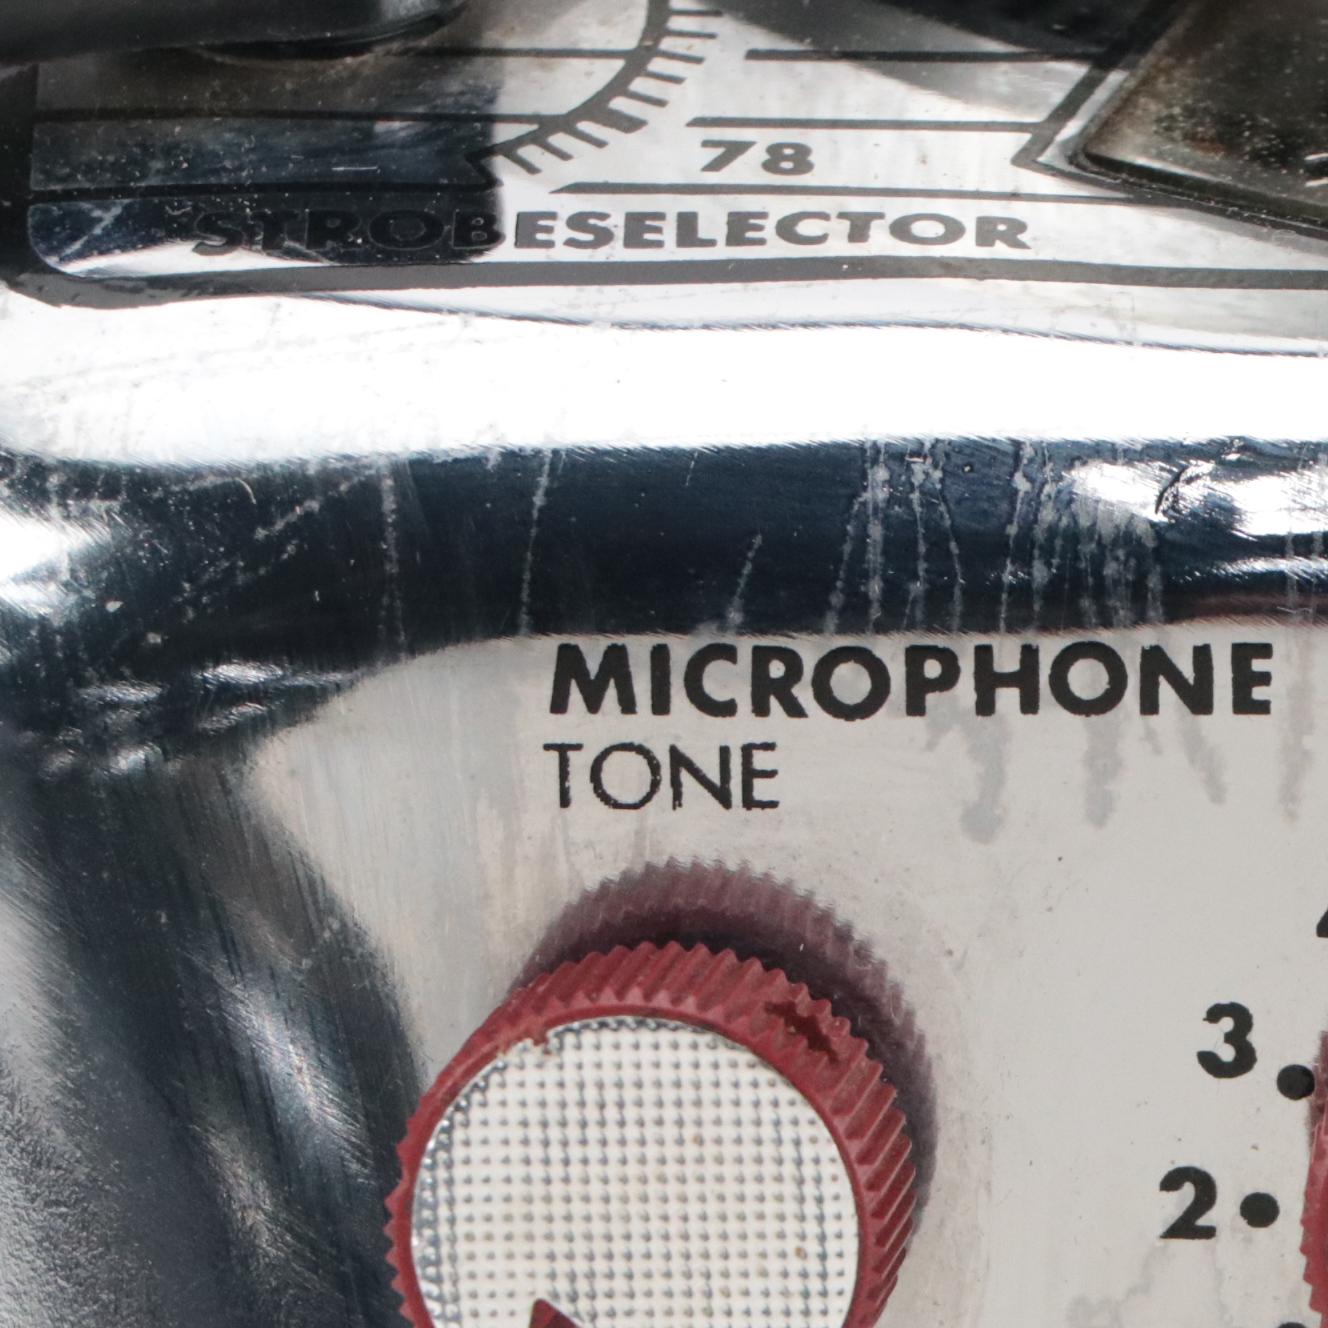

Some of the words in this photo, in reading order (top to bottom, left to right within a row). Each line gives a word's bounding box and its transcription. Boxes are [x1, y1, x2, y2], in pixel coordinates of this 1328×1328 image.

[700, 139, 816, 176] 78
[193, 208, 1031, 258] STROBESELECTOR
[549, 640, 1274, 720] MICROPHONE
[543, 741, 780, 810] TONE
[1197, 1002, 1257, 1079] 3
[1159, 1166, 1218, 1240] 2
